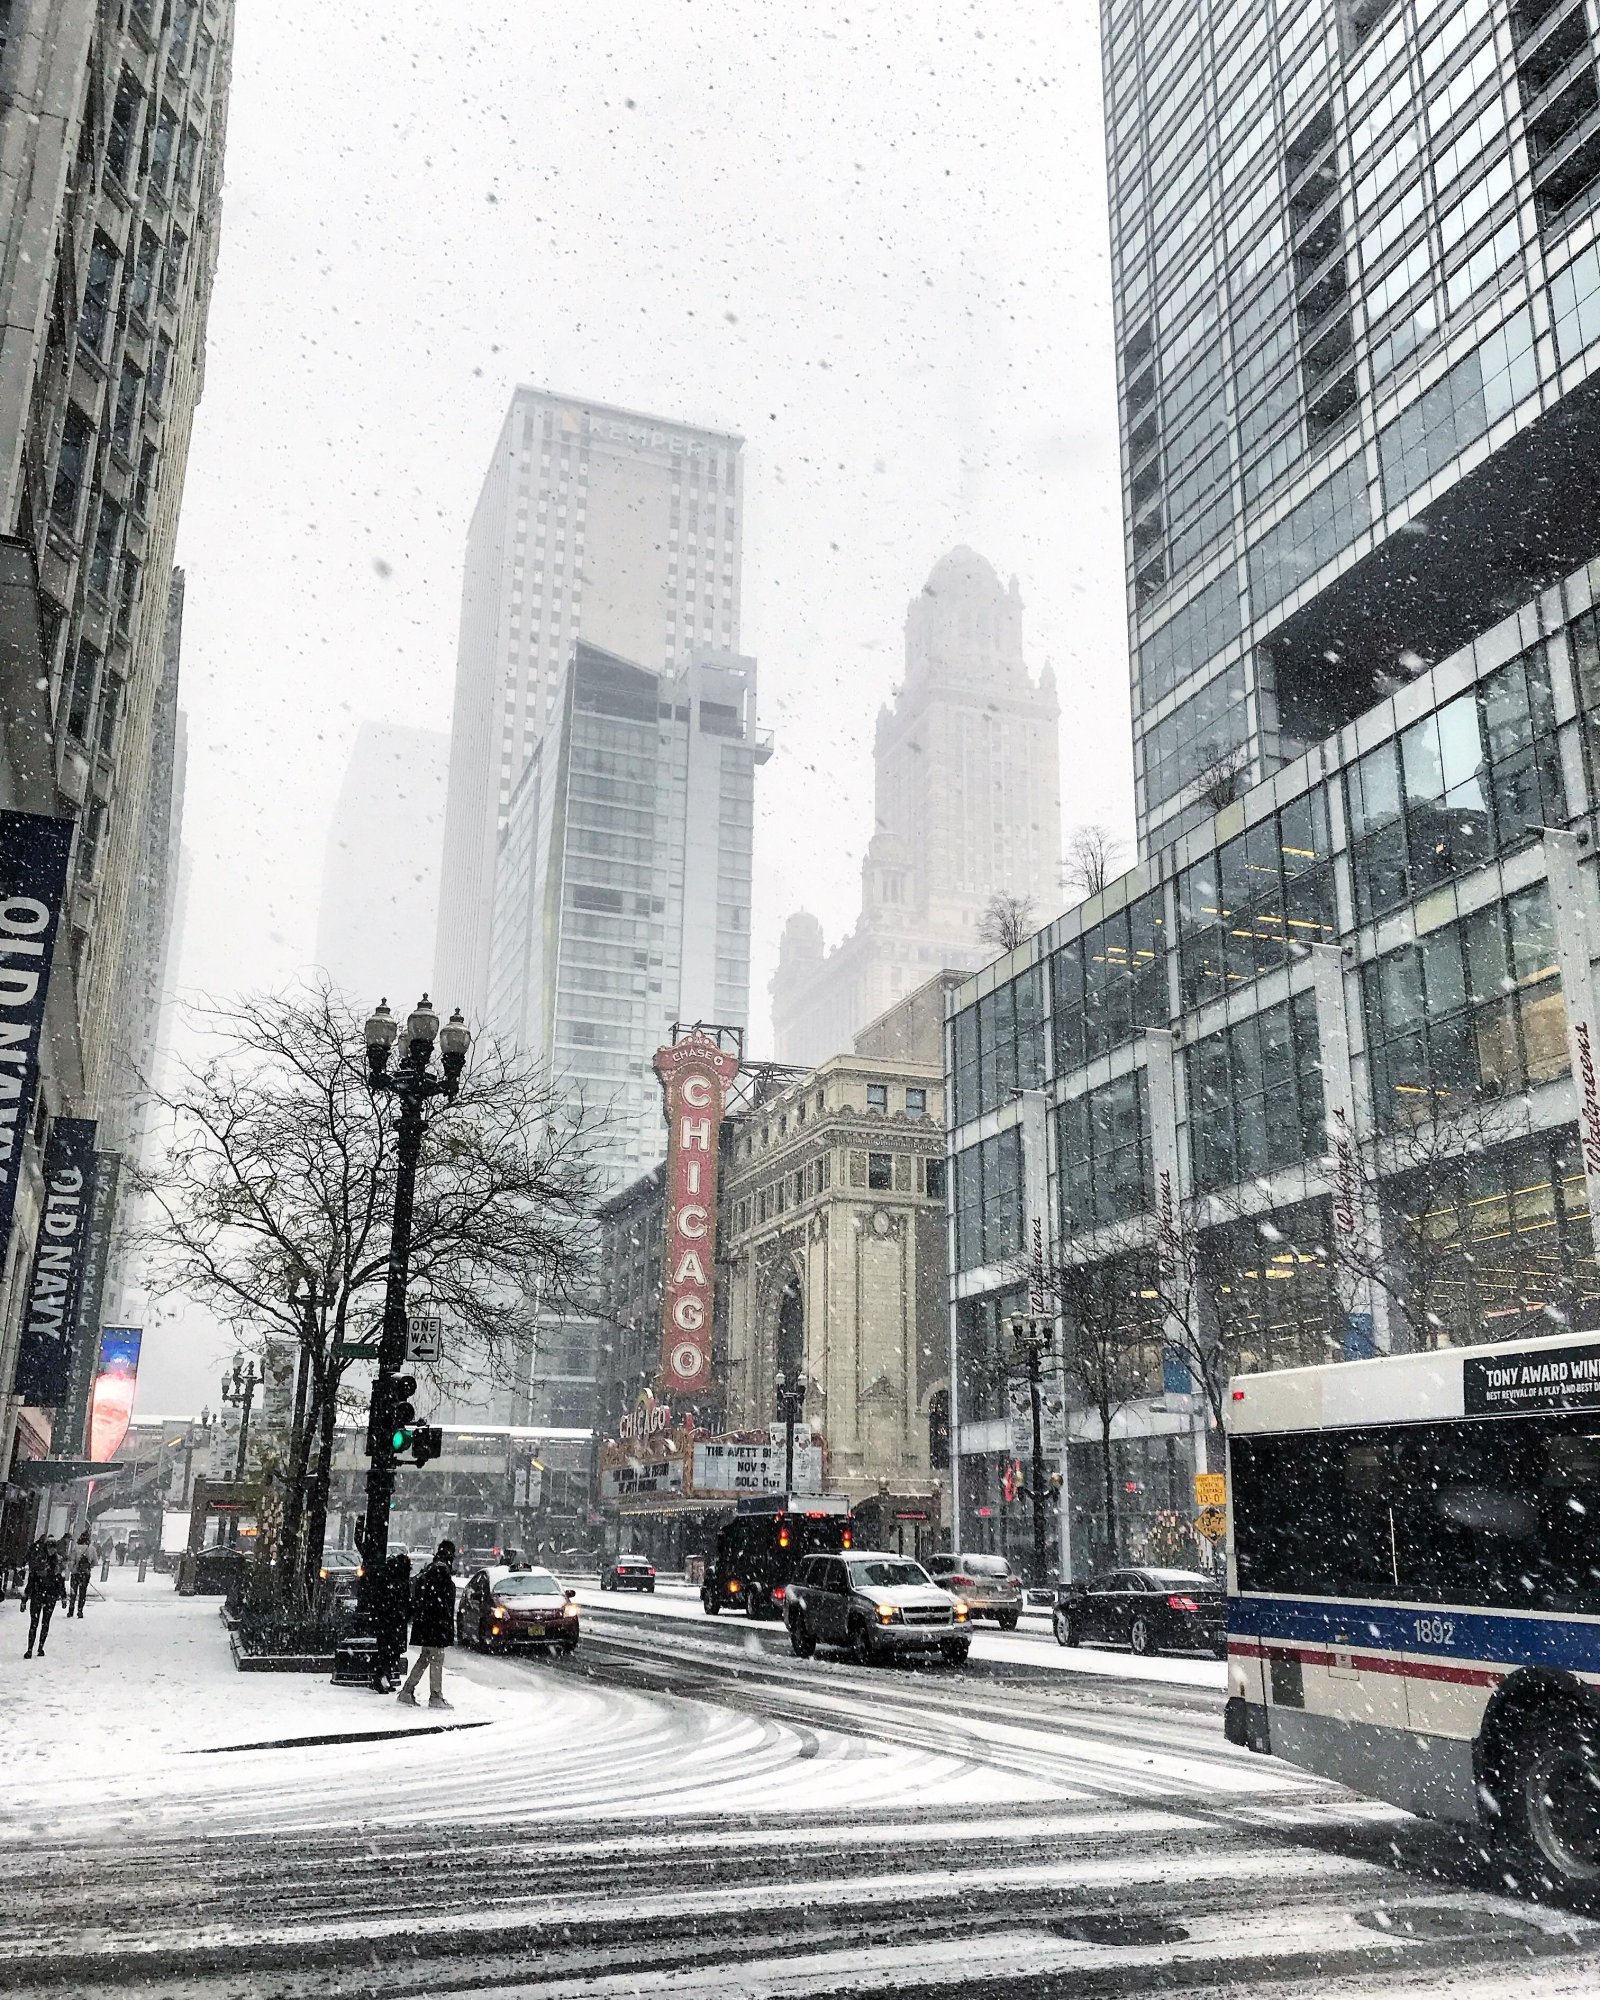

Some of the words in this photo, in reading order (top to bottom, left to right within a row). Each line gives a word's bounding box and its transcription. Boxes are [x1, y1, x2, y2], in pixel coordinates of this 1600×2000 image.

[589, 415, 707, 457] KEMPER
[672, 1048, 713, 1062] CHASE
[44, 1169, 83, 1237] OLD
[671, 1074, 712, 1379] CHICAGO
[28, 1245, 72, 1340] NAVY
[411, 1320, 437, 1332] ONE
[410, 1332, 437, 1344] WAY
[1486, 1367, 1518, 1387] TONY
[1521, 1362, 1569, 1384] AWARD
[1486, 1391, 1501, 1401] BEST
[1502, 1388, 1527, 1400] REVIVAL
[1527, 1387, 1537, 1397] OF
[1538, 1387, 1543, 1396] A
[1544, 1385, 1560, 1395] PLAY
[1561, 1383, 1576, 1394] AND
[1576, 1383, 1592, 1393] BEST
[620, 1405, 666, 1438] CHICAGO
[705, 1445, 724, 1457] THE
[728, 1447, 758, 1458] AVETT
[737, 1461, 757, 1472] NOV
[735, 1476, 758, 1487] SOLD
[1414, 1620, 1455, 1645] 1892
